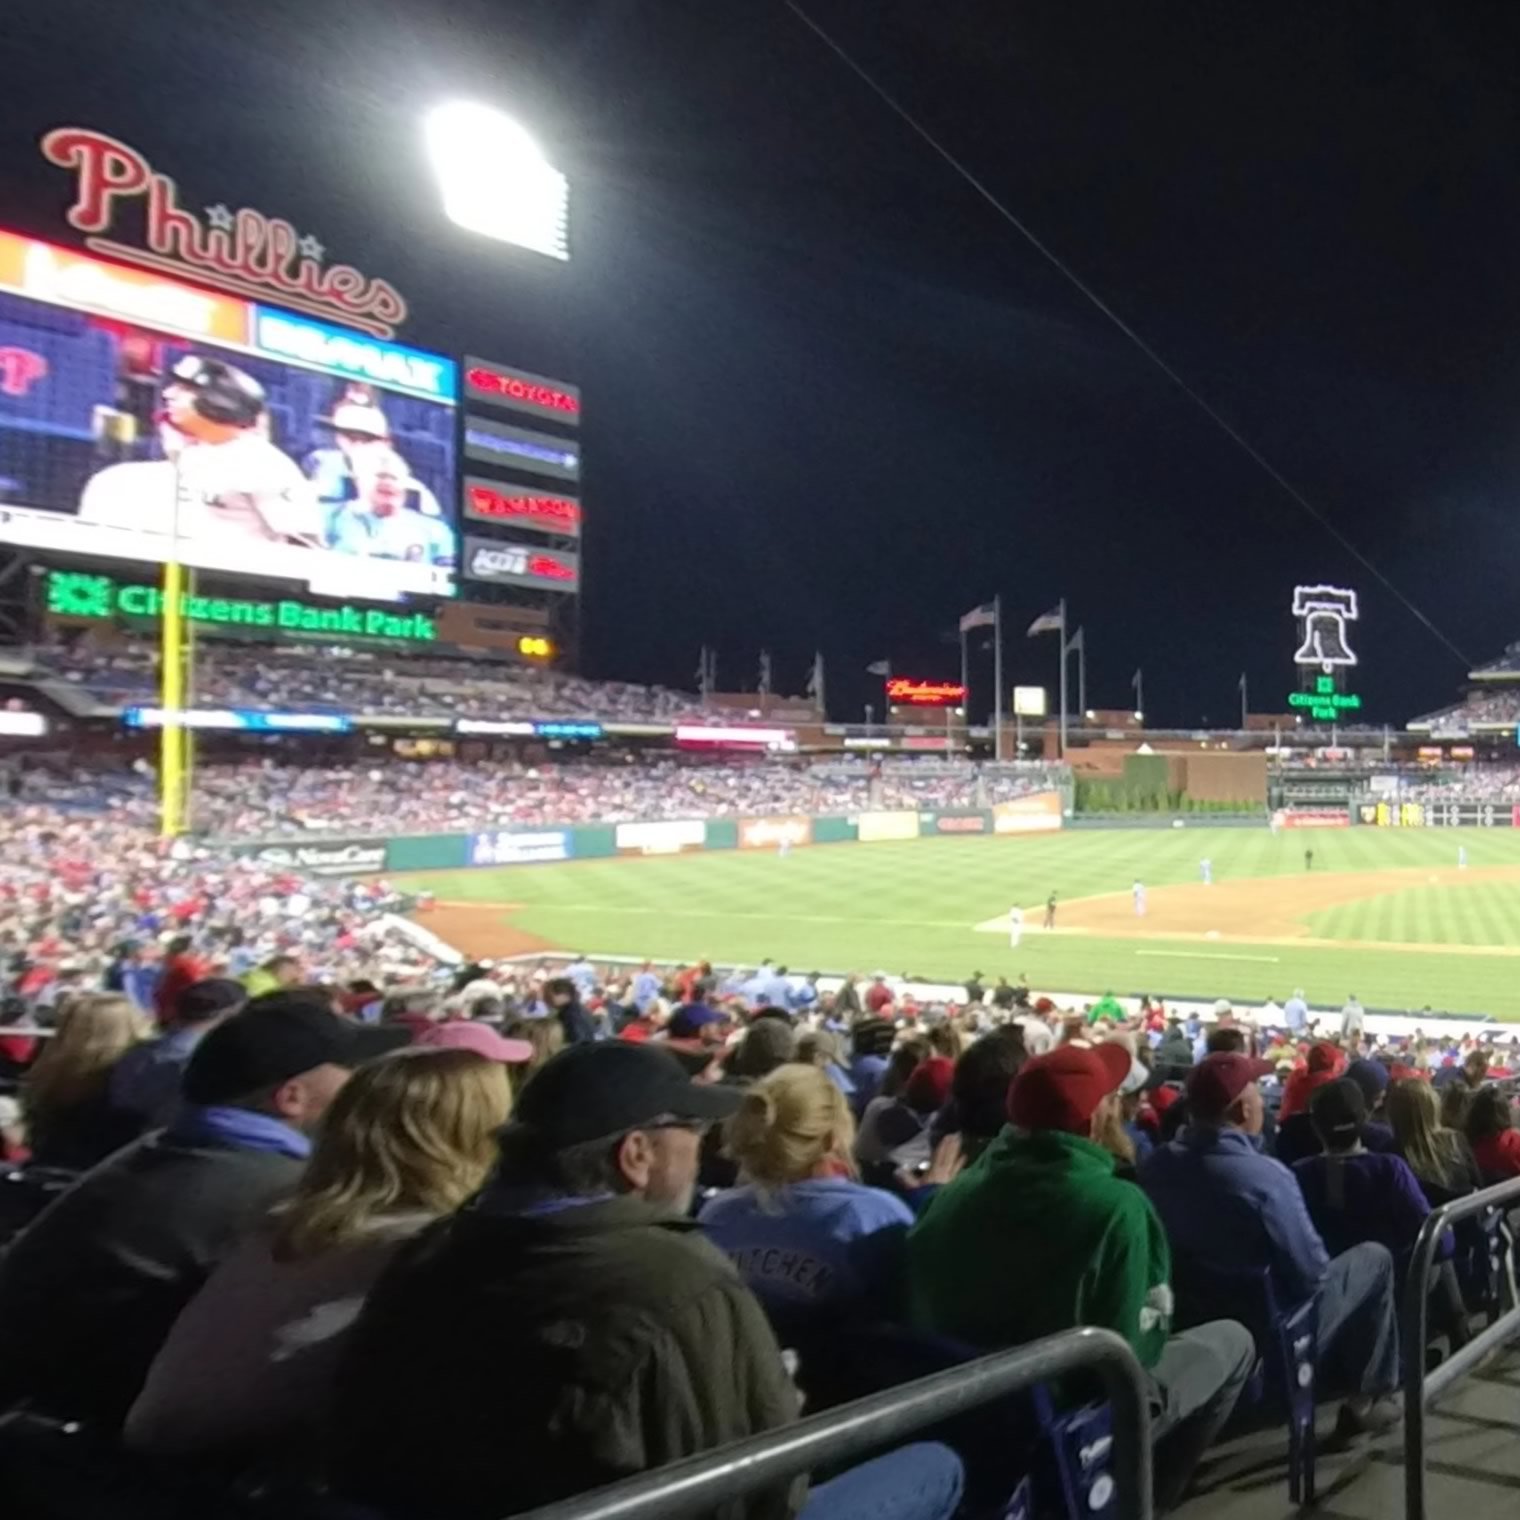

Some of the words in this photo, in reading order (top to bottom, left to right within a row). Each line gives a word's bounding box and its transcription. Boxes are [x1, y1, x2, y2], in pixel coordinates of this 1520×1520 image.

[41, 127, 407, 326] Phillies
[498, 376, 578, 413] TOYOTA
[118, 585, 274, 625] Ciizens
[279, 602, 361, 632] Bank
[366, 610, 435, 639] Park
